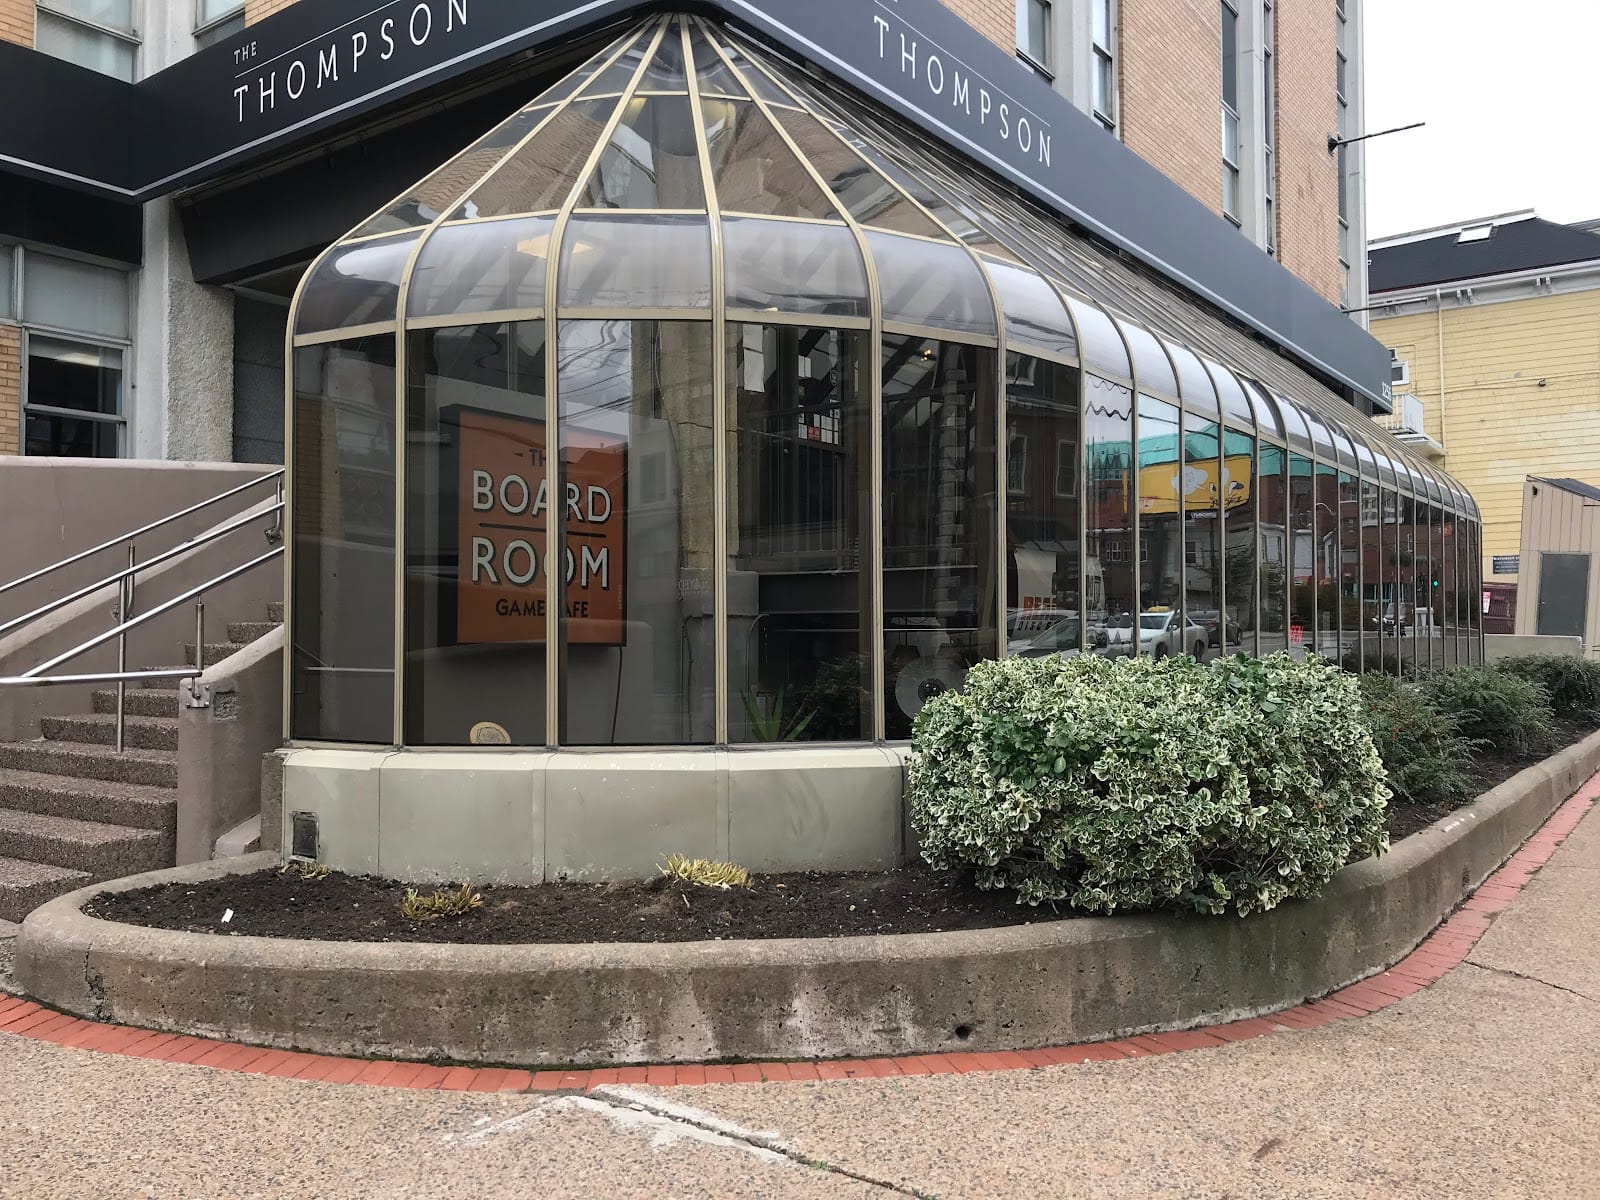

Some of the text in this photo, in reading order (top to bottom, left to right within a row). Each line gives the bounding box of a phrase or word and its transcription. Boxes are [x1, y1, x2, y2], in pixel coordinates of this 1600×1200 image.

[233, 41, 258, 65] THE
[233, 0, 467, 122] THOMPSON
[873, 15, 1051, 168] THOMPSON
[528, 448, 547, 467] TH
[495, 598, 546, 617] GAME
